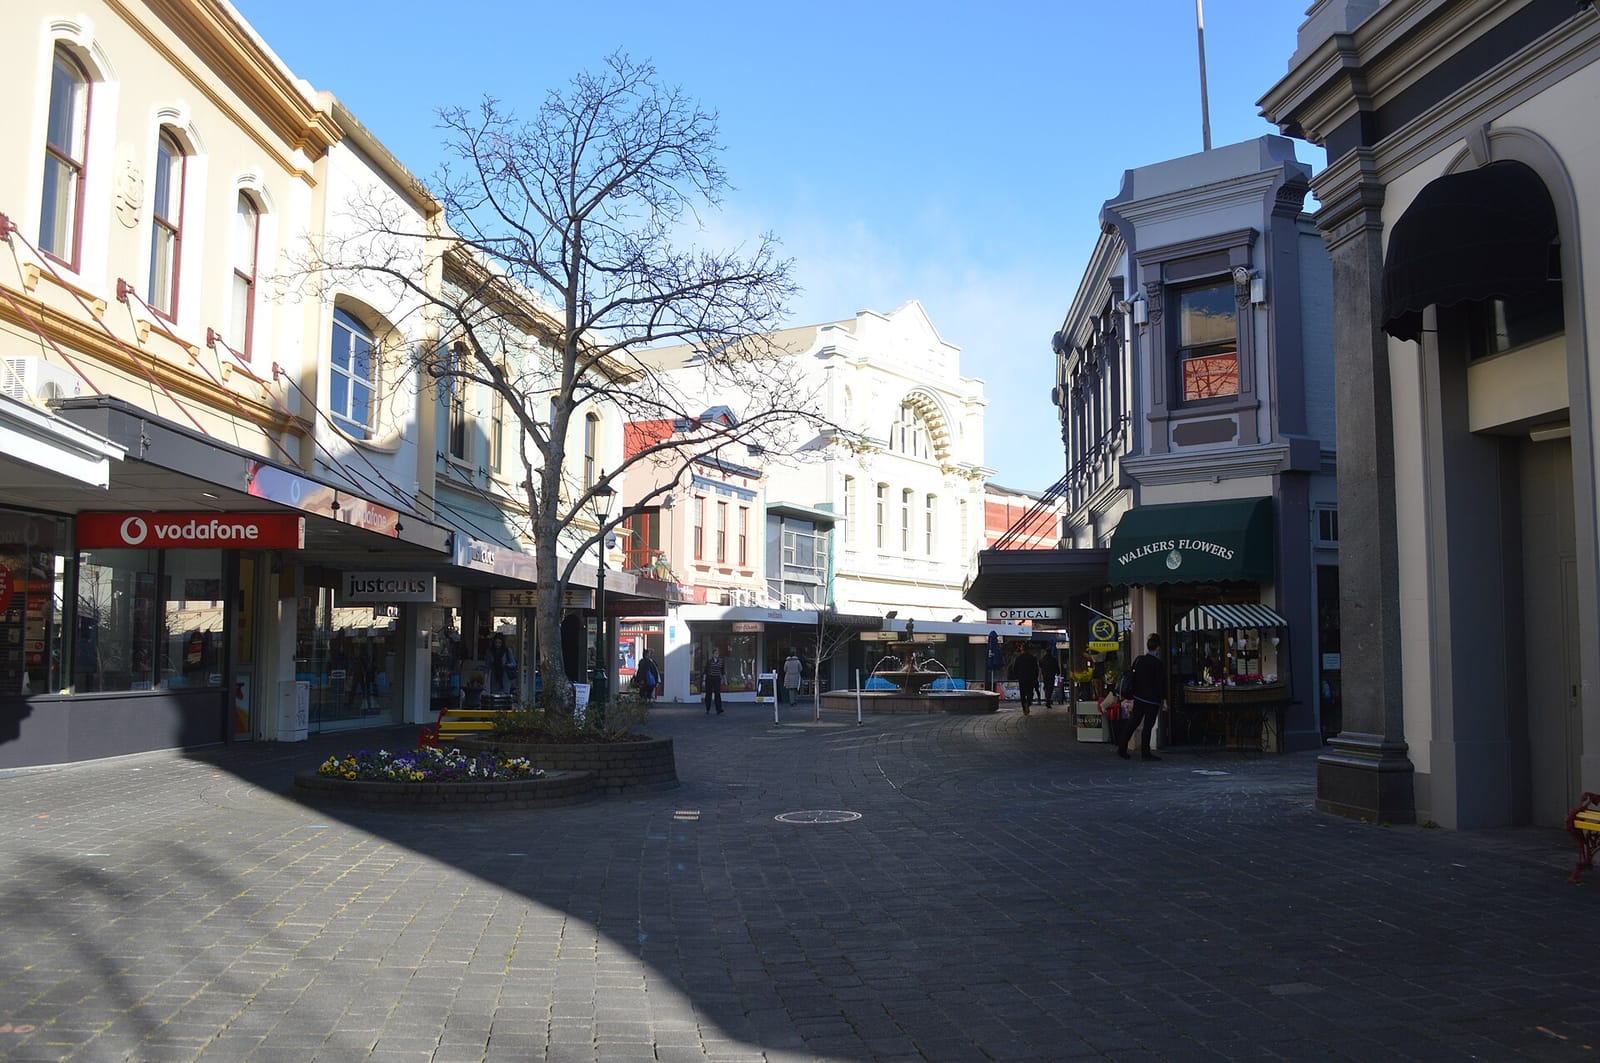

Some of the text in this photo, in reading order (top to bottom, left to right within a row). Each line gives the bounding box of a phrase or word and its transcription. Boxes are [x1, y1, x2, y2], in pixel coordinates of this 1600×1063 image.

[154, 519, 259, 540] vodafone
[1118, 539, 1234, 566] WALKERS FLOWERS
[1000, 610, 1049, 619] OPTICAL
